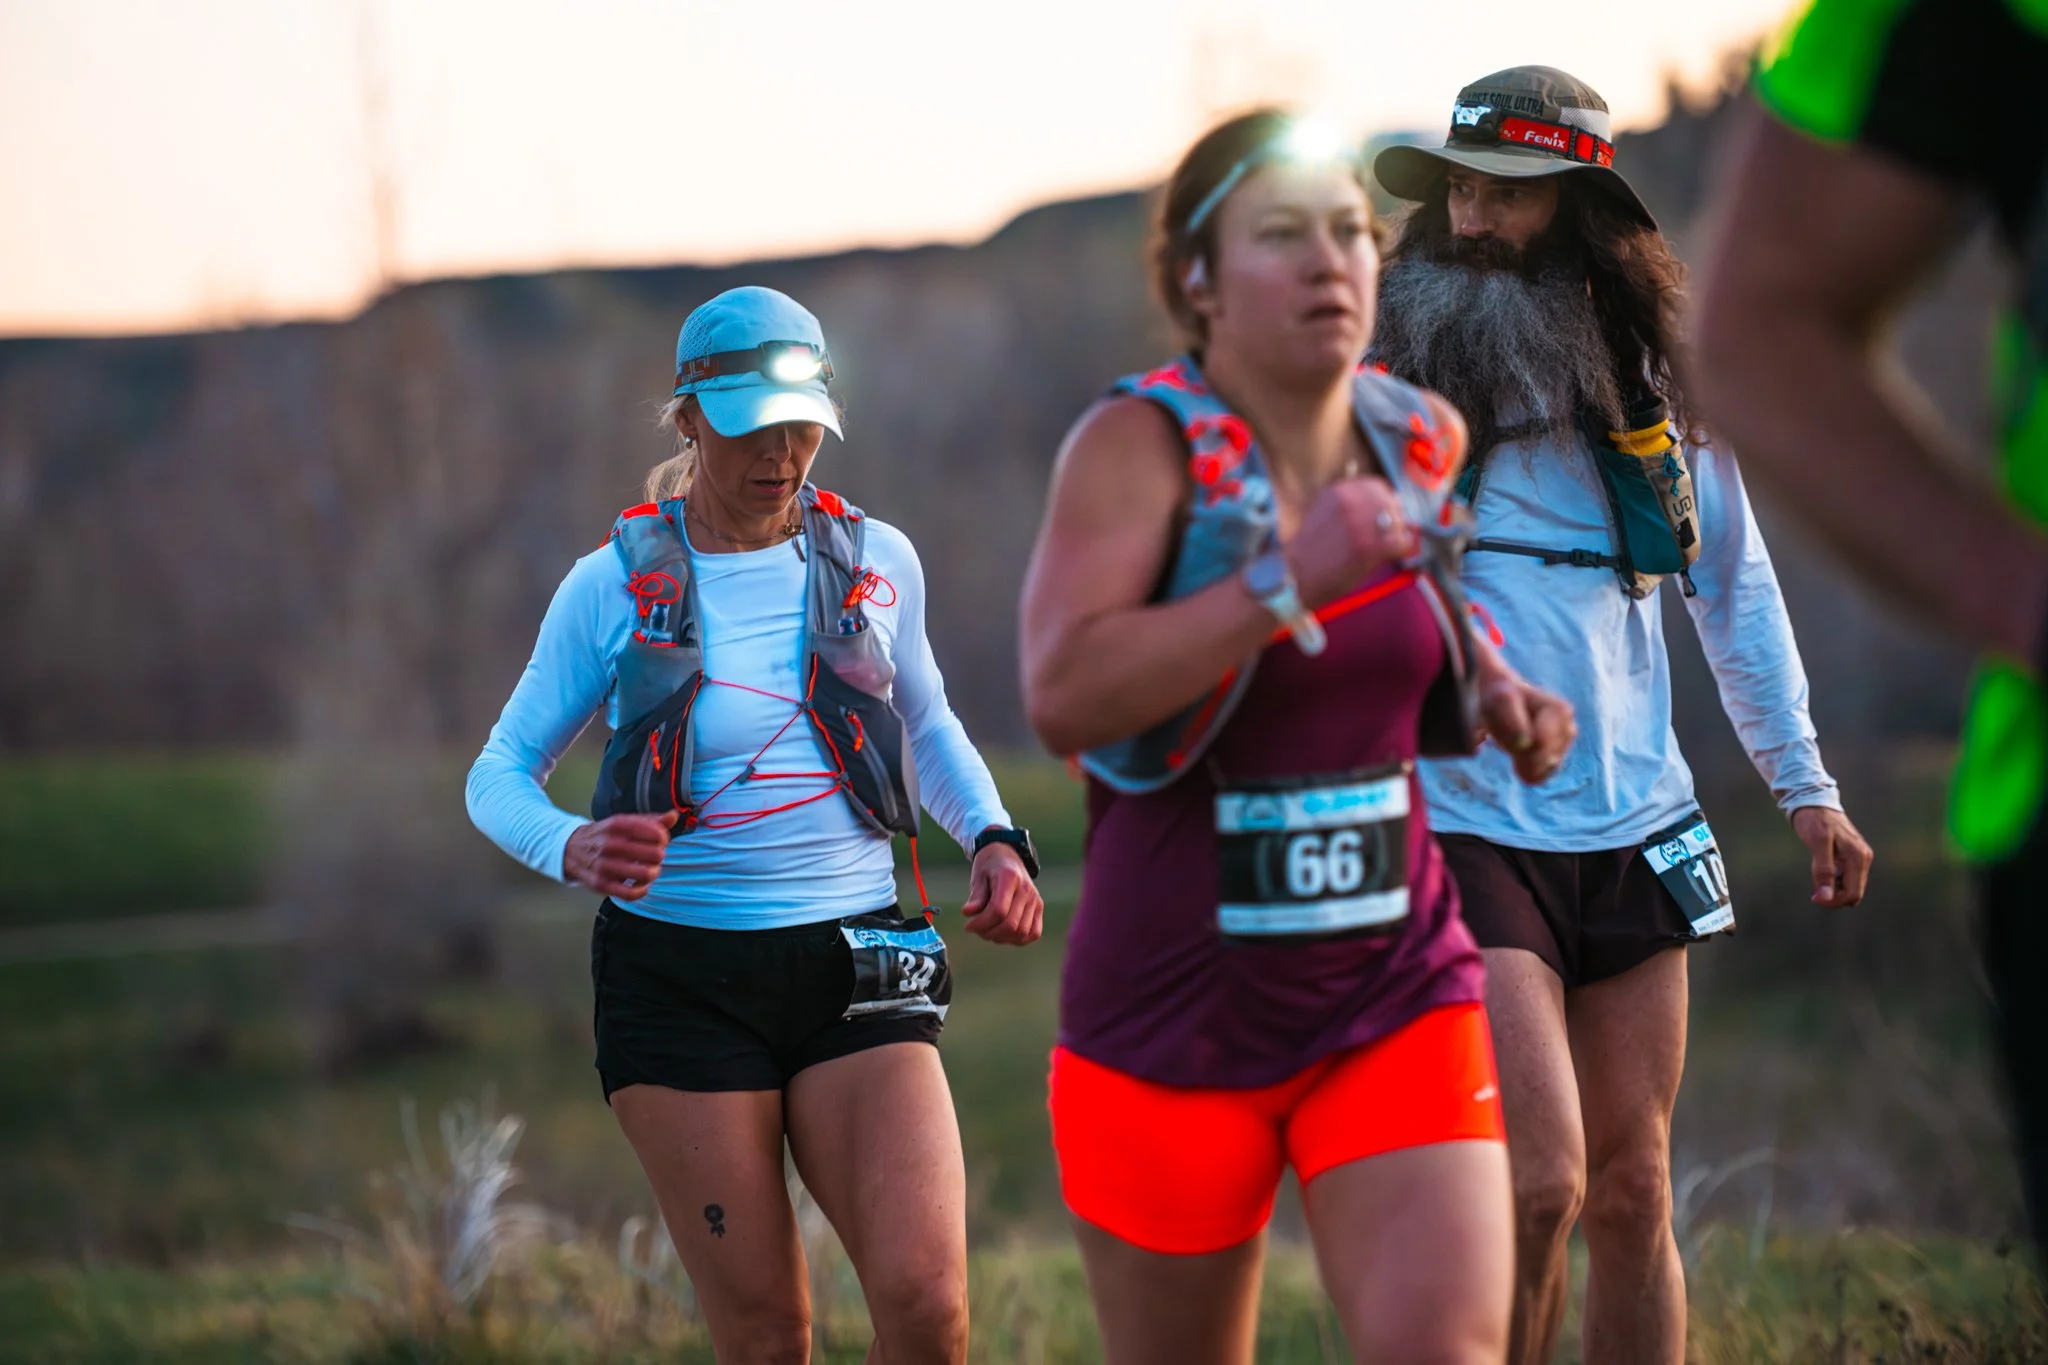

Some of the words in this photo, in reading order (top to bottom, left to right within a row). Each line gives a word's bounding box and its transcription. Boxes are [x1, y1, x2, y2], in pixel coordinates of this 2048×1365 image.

[1490, 93, 1513, 109] SOUL
[1515, 96, 1545, 116] ULTRA
[1286, 829, 1364, 898] 66
[898, 951, 936, 992] 34
